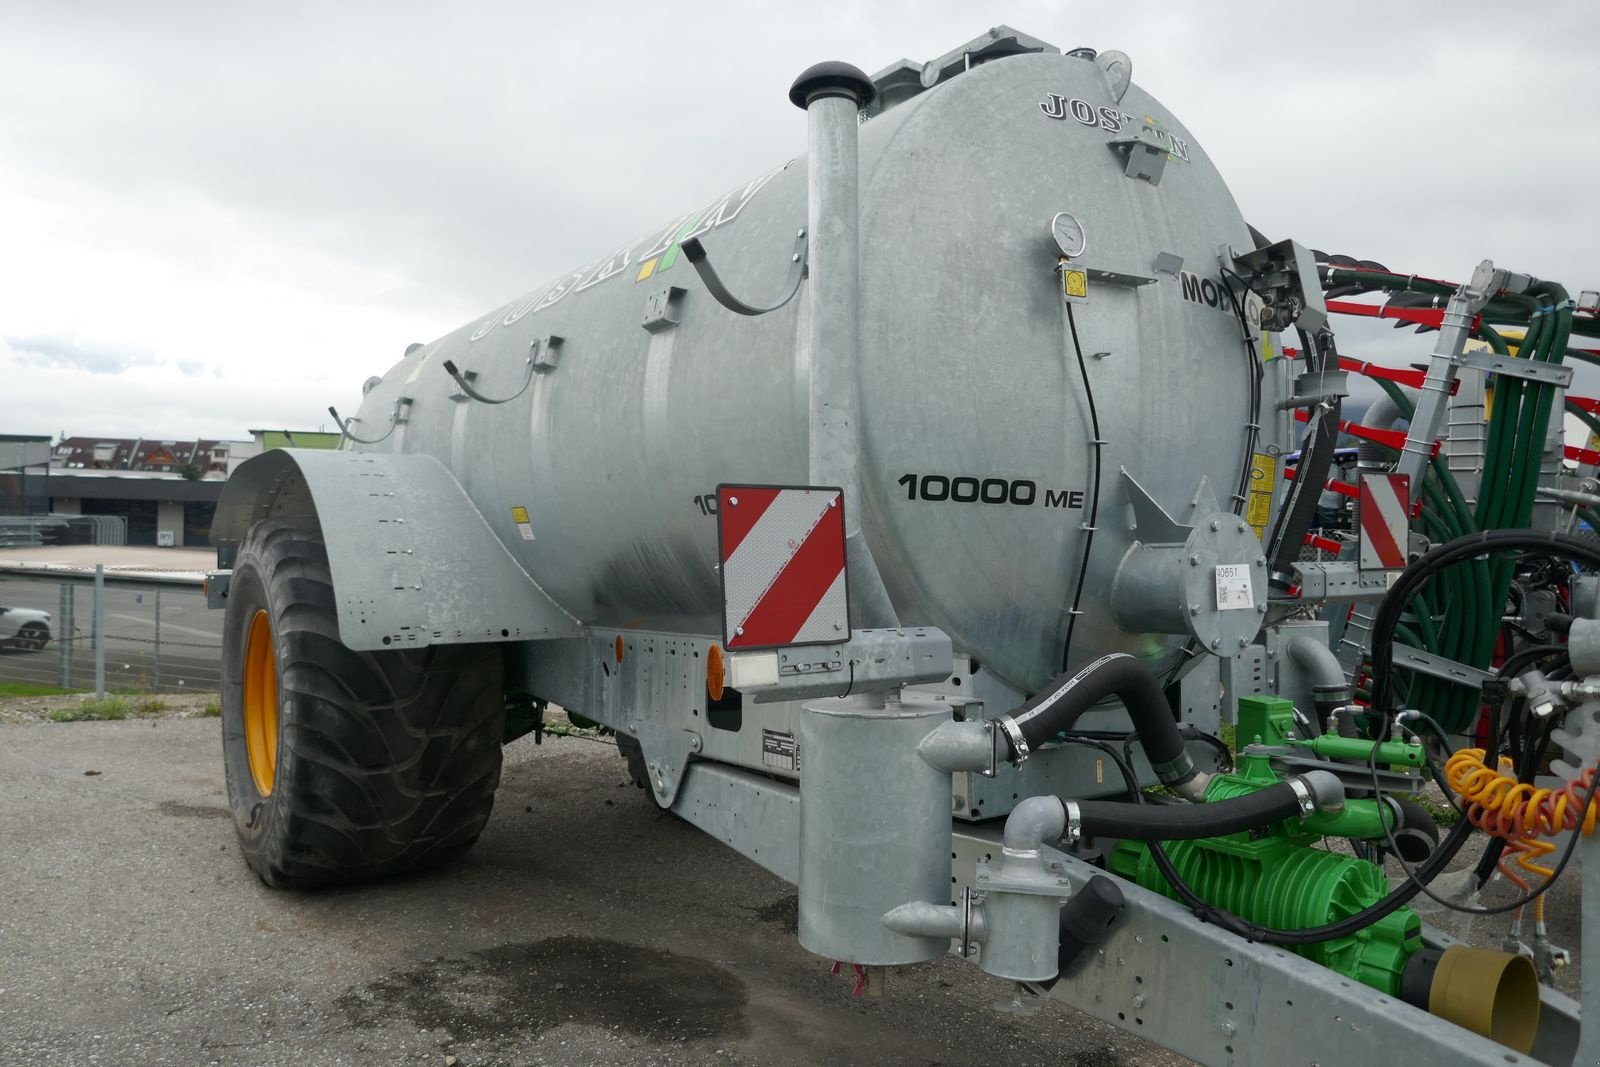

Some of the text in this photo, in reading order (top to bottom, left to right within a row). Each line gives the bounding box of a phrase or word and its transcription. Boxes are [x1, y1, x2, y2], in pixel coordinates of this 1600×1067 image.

[1039, 93, 1190, 163] JOSN
[898, 474, 1084, 509] 10000 ME
